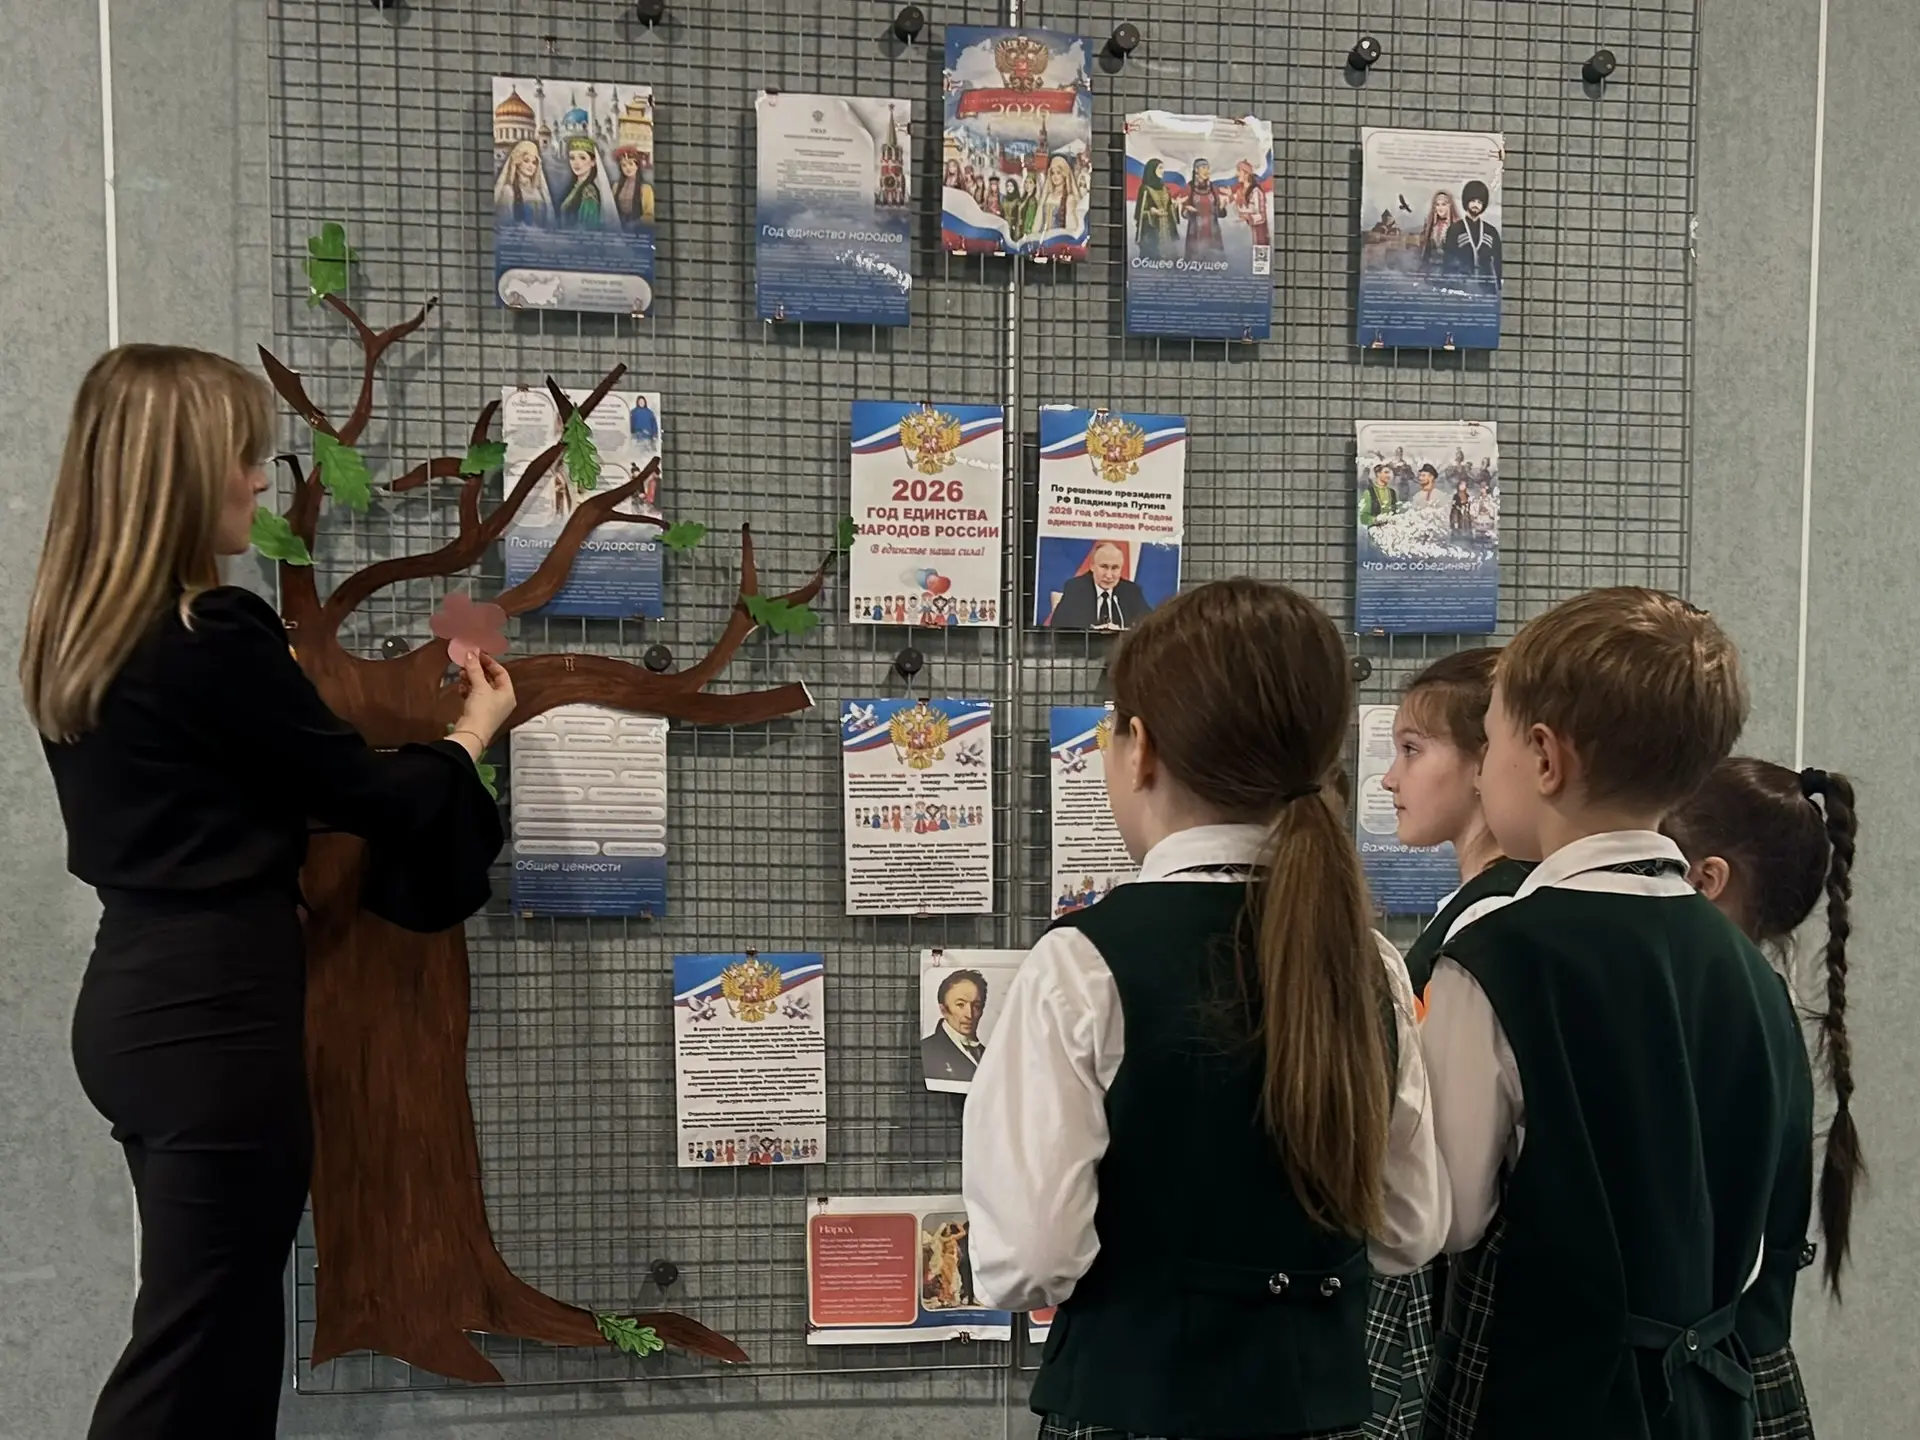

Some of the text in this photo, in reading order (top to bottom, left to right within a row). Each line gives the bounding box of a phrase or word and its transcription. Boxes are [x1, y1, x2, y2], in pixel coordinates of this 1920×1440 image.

[992, 102, 1051, 121] 2026
[762, 224, 903, 244] Год единства народов
[1131, 257, 1229, 272] Общее будущее
[892, 479, 963, 502] 2026
[1051, 484, 1172, 500] По решению президента
[1057, 496, 1165, 510] РФ Владимира Путина
[867, 507, 988, 521] ГОД ЕДИНСТВА
[1075, 509, 1091, 517] год
[1094, 509, 1140, 519] объявлен
[1142, 512, 1173, 522] Годом
[936, 526, 999, 538] РОССИИ
[1048, 518, 1173, 533] единства народов России
[580, 538, 656, 552] осударства
[870, 543, 985, 556] В единстве наша сила!
[1362, 559, 1483, 572] Что нас объединяет?
[1362, 842, 1408, 852] Важные
[515, 860, 622, 873] Общие ценности
